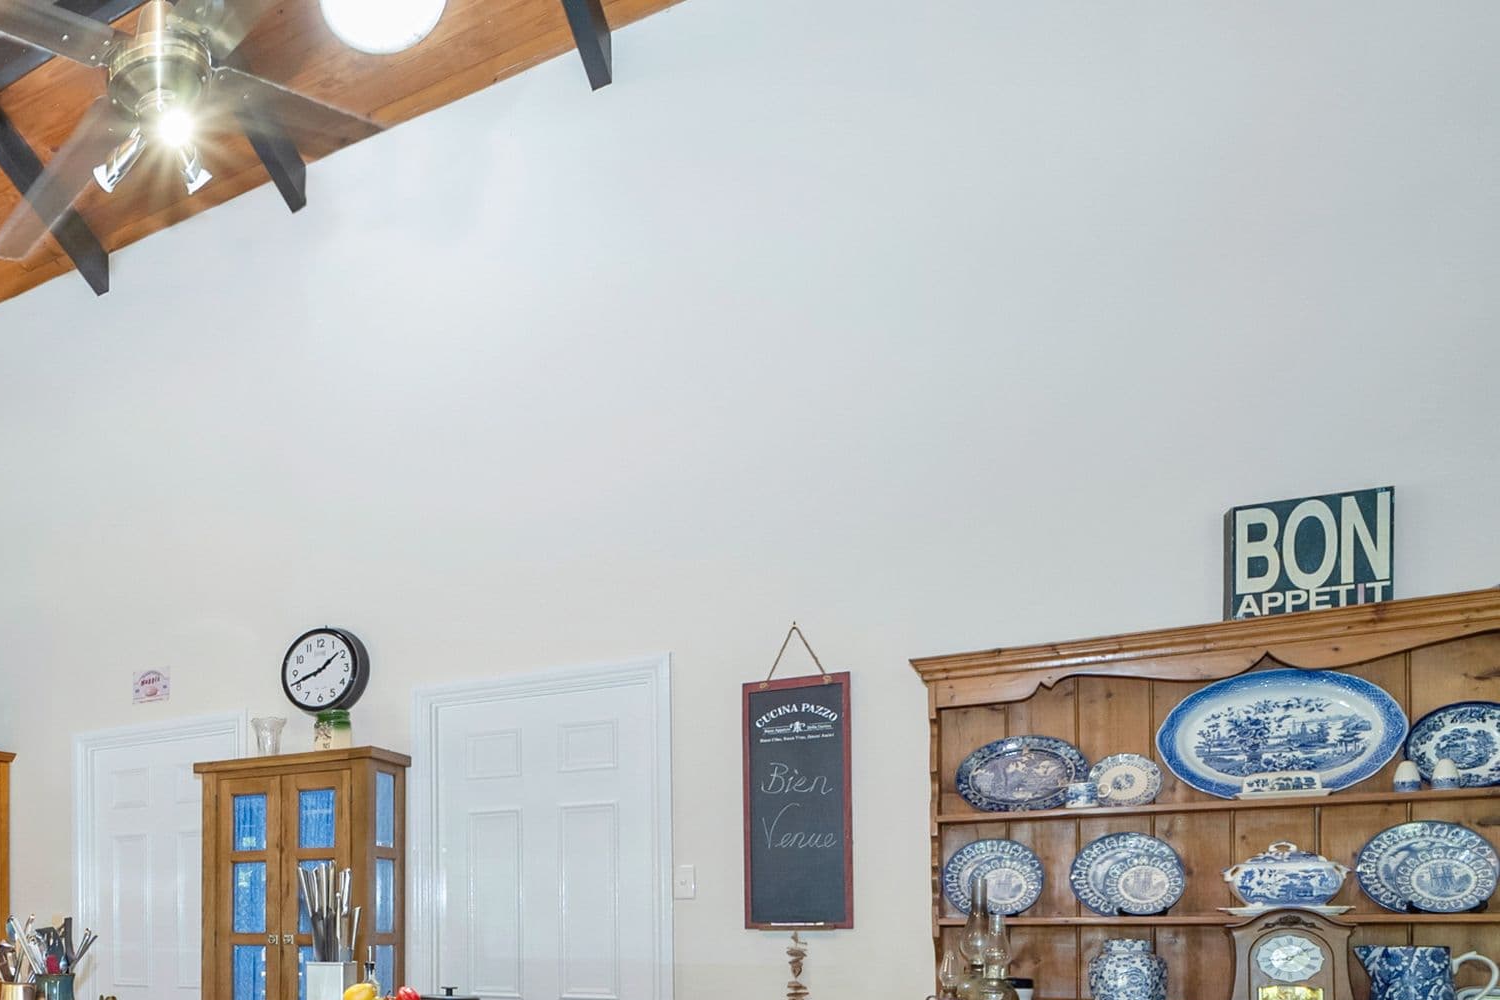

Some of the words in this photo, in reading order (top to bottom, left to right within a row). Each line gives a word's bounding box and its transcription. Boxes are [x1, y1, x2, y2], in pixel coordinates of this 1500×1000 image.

[1235, 490, 1391, 595] BON
[1235, 581, 1391, 619] APPETIT
[317, 639, 325, 648] 12
[306, 644, 312, 653] 11
[340, 650, 346, 659] 2
[296, 656, 304, 665] 10
[343, 663, 349, 672] 3
[292, 669, 298, 678] 9
[340, 678, 345, 686] 4
[304, 691, 311, 701] 7
[330, 688, 336, 697] 5
[317, 694, 324, 702] 6
[755, 703, 798, 728] CUCINA
[801, 703, 838, 721] PAZZO
[761, 762, 833, 795] Bien
[762, 802, 837, 849] Venue
